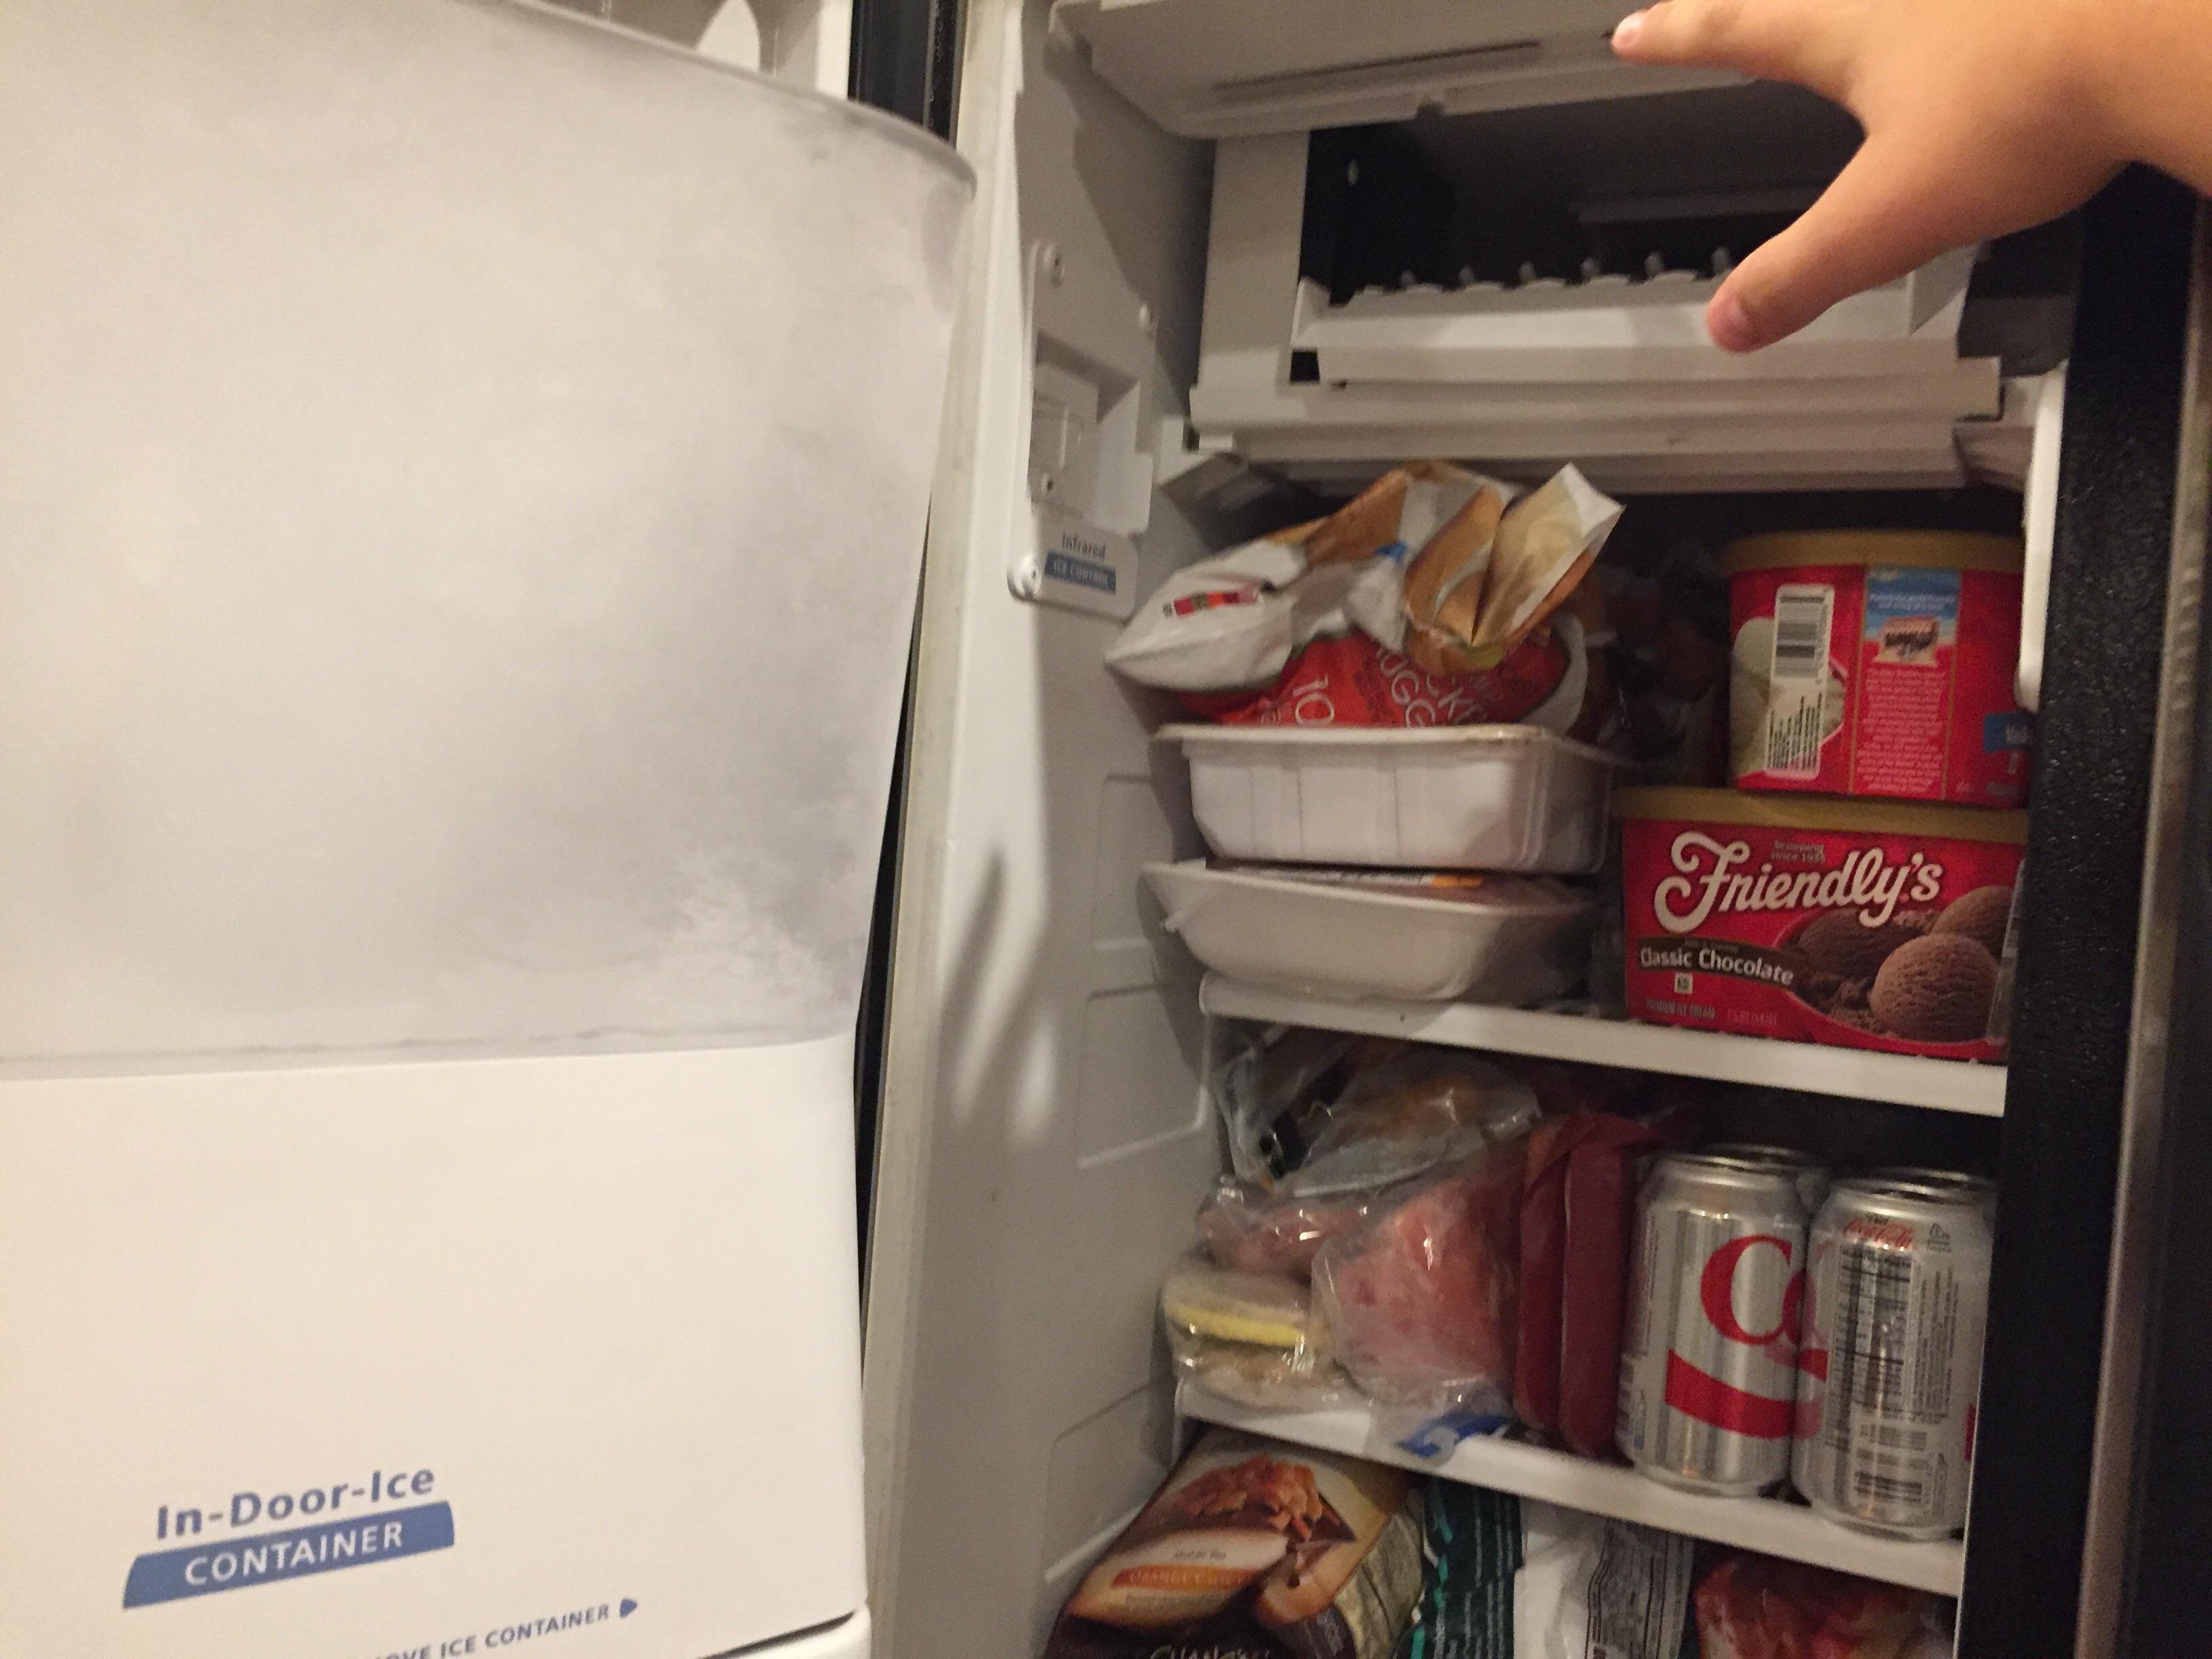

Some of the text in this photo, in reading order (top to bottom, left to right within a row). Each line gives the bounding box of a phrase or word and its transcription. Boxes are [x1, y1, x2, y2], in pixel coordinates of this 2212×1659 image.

[1654, 831, 1943, 933] Friendly's
[1641, 946, 1692, 969] Classic
[1698, 947, 1795, 986] Chocolate
[157, 1469, 434, 1540] In-Door-Ice
[184, 1521, 404, 1586] CONTAINER
[441, 1635, 477, 1659] ICE
[484, 1603, 609, 1649] CONTAINER
